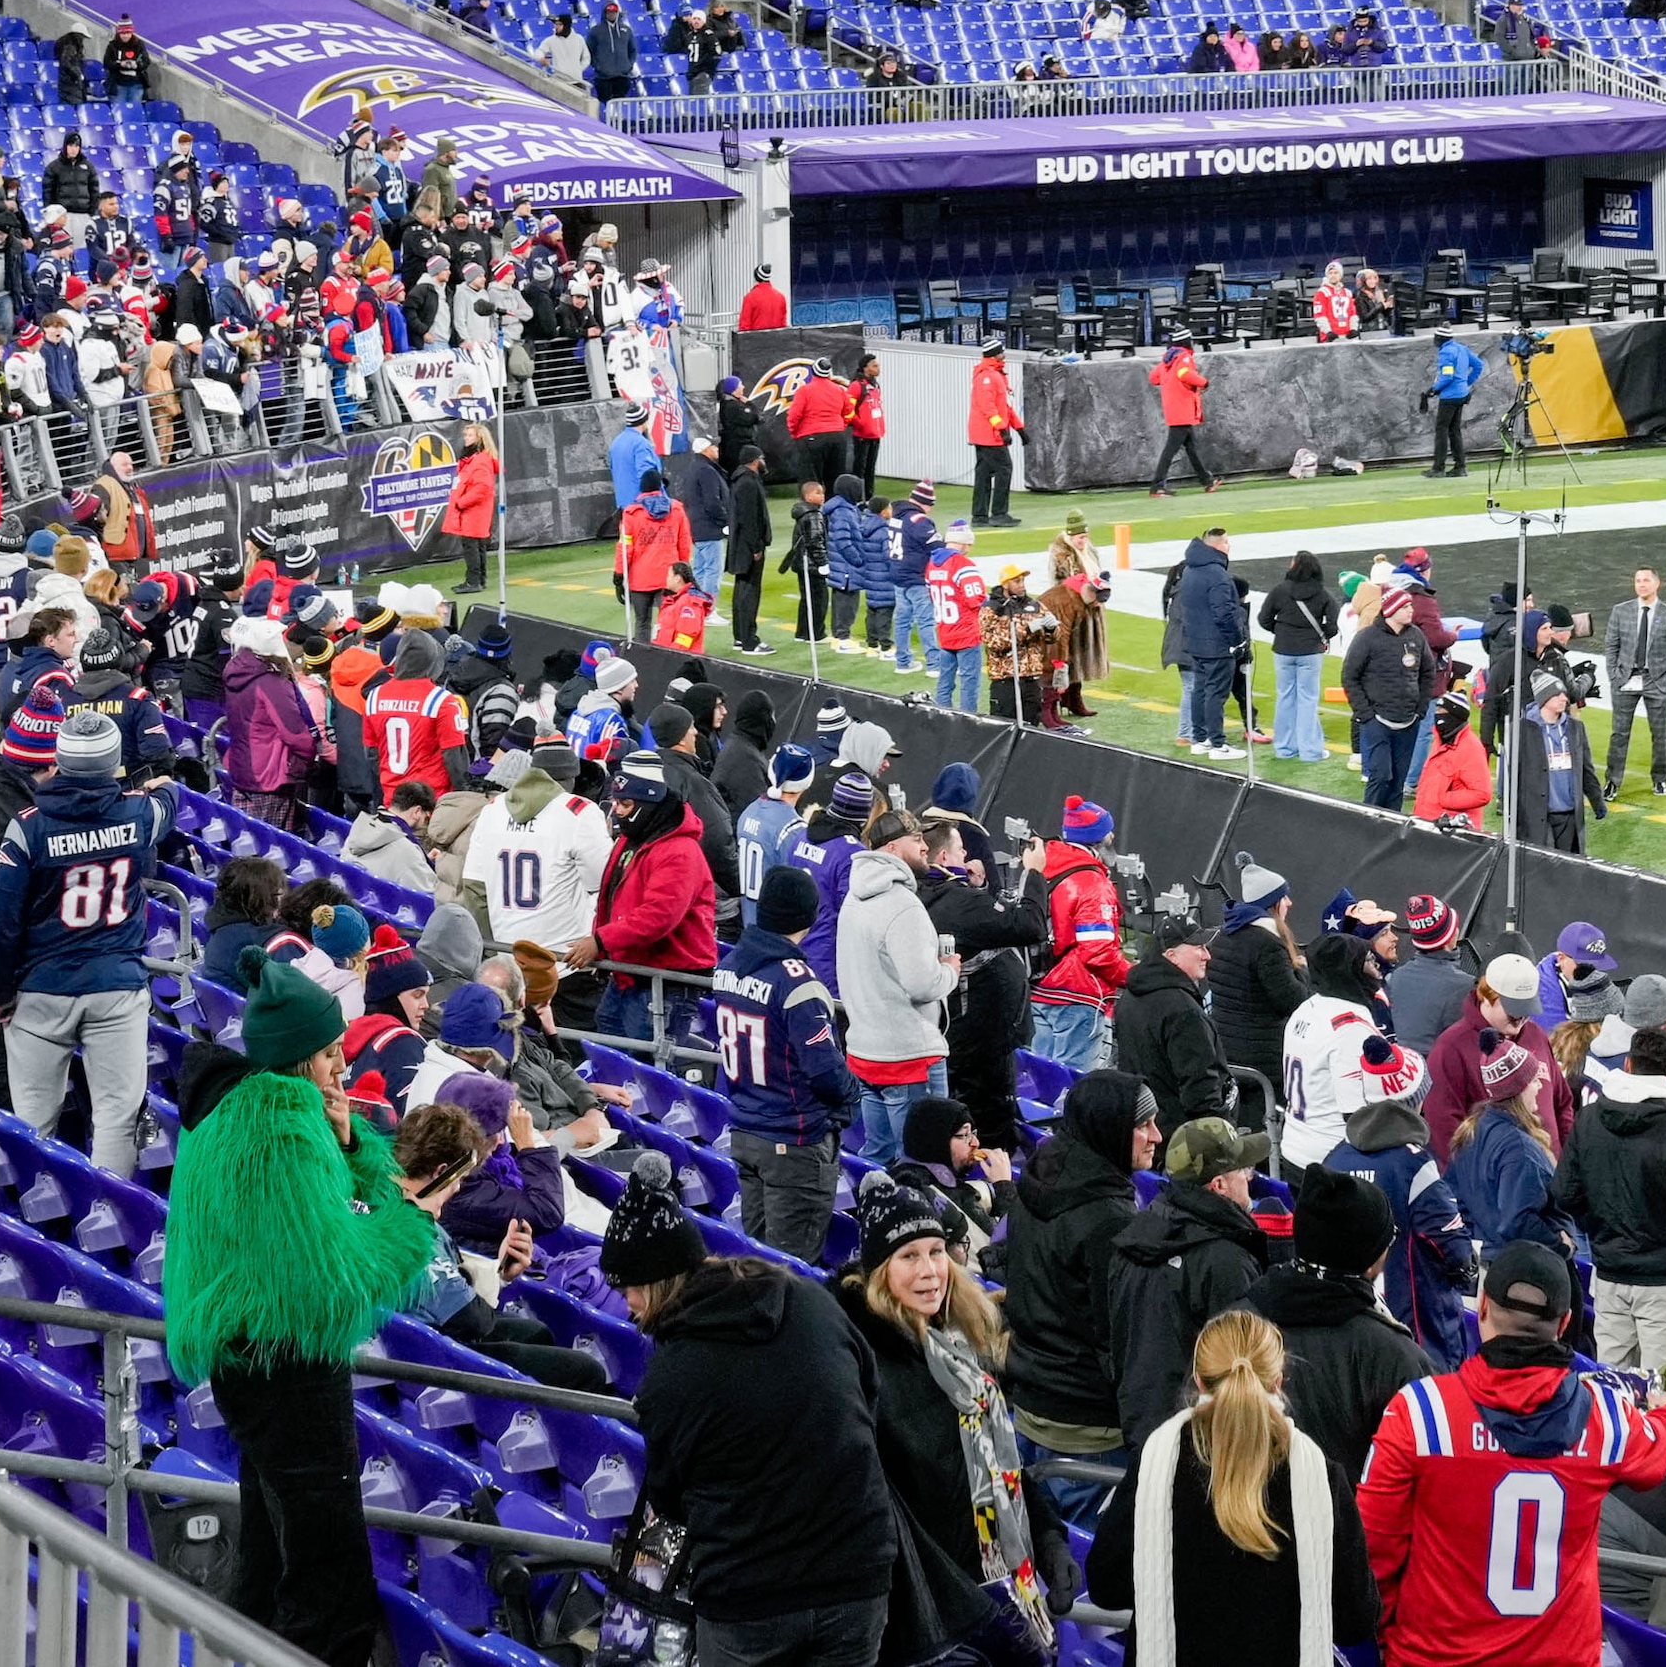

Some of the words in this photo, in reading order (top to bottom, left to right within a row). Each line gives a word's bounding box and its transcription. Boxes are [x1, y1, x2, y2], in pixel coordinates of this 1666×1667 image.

[231, 31, 464, 74] HEALTH
[1036, 154, 1097, 185] BUD
[1104, 150, 1191, 182] LIGHT
[1200, 140, 1384, 176] TOUCHDOWN
[1390, 136, 1464, 166] CLUB
[503, 178, 597, 204] MEDSTAR
[600, 176, 673, 200] HEALTH
[1604, 194, 1633, 210] BUD
[1599, 209, 1639, 228] LIGHT
[103, 230, 128, 251] 12
[415, 360, 454, 381] MAYE
[420, 472, 452, 492] RAVENS
[965, 582, 982, 597] 86
[932, 586, 955, 624] 86
[378, 696, 420, 714] GONZALEZ
[383, 717, 410, 775] 0
[743, 816, 761, 838] MAYE
[47, 823, 138, 860] HERNANDEZ
[793, 838, 827, 866] JACKSON
[499, 850, 541, 910] 10
[737, 837, 764, 901] 10
[58, 859, 131, 931] 81
[1292, 1020, 1308, 1041] MAYE
[717, 1008, 768, 1087] 87
[195, 1518, 210, 1535] 12
[1487, 1472, 1565, 1618] 0
